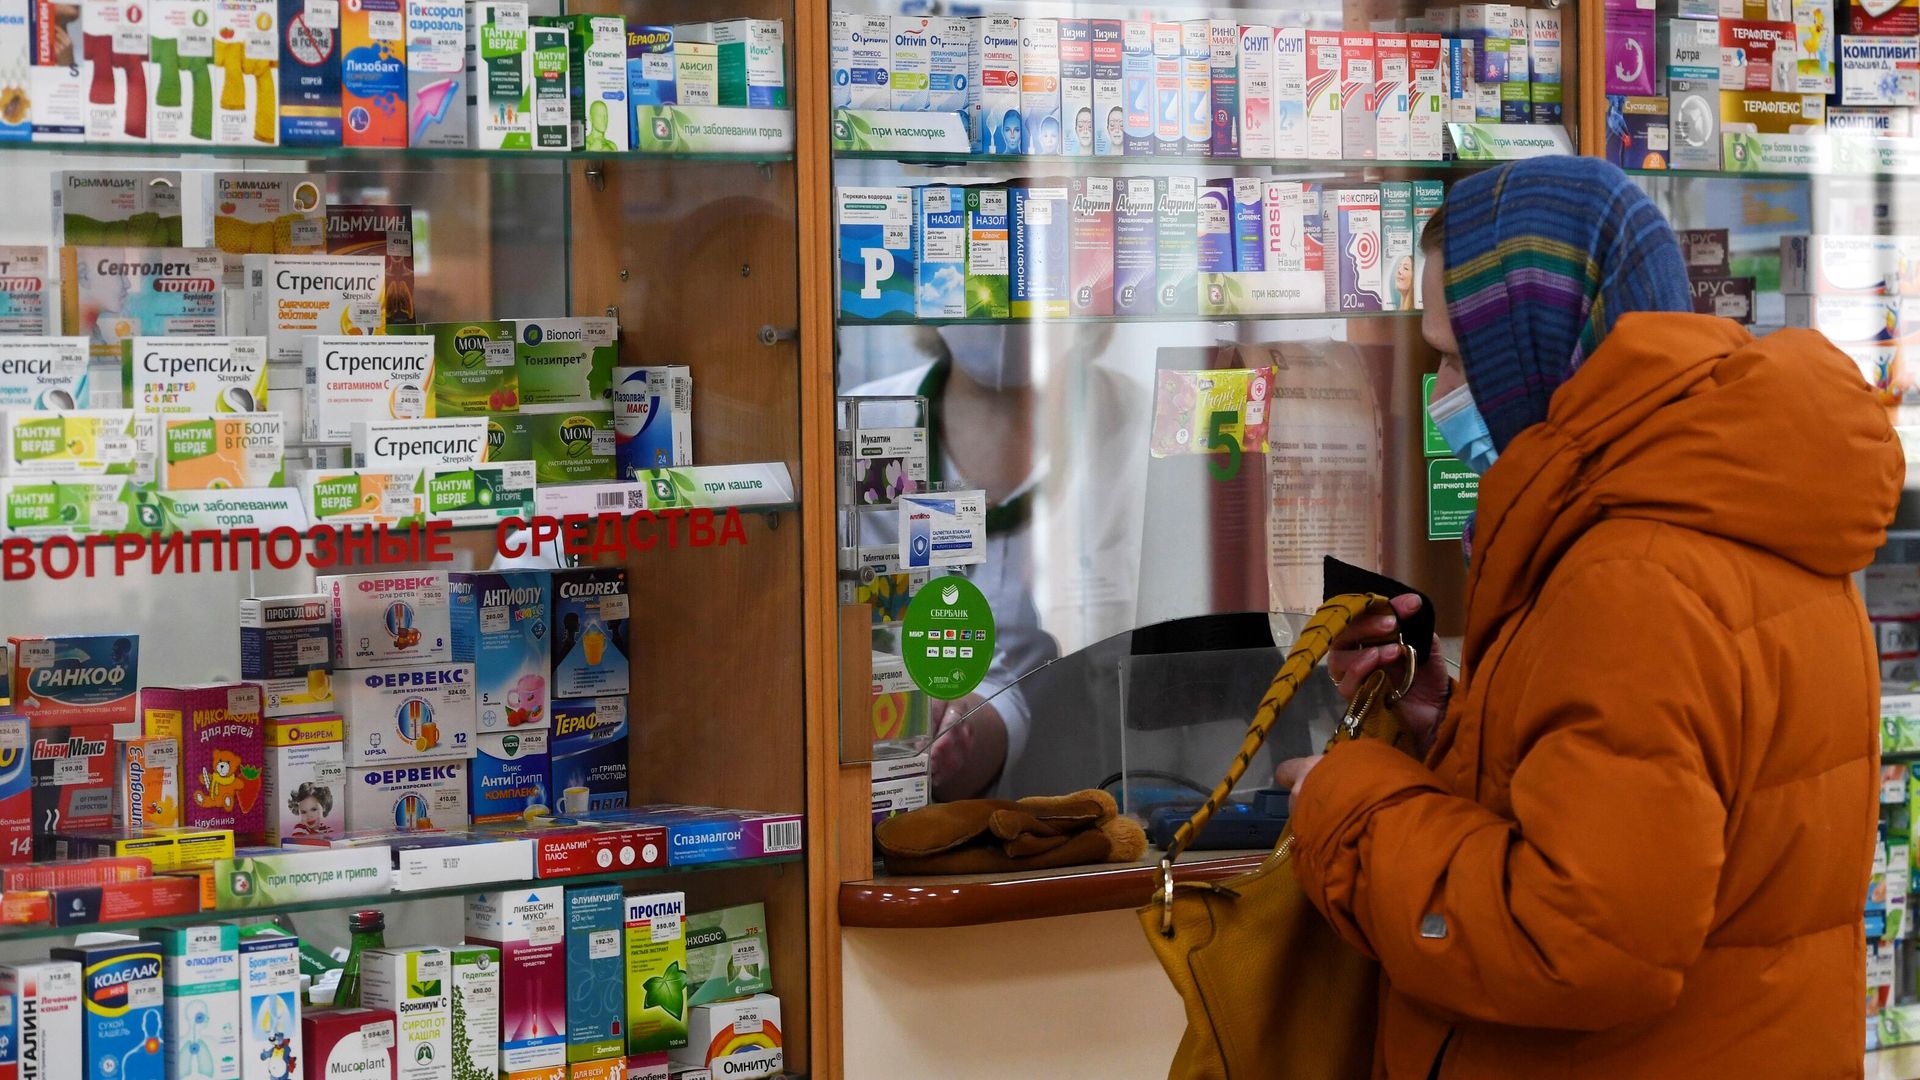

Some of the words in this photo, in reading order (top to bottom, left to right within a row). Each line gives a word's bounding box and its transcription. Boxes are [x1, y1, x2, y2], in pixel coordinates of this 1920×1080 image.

[409, 4, 464, 20] Гексорал
[410, 20, 464, 33] аэрозоль
[1535, 20, 1559, 30] АКВА
[484, 27, 523, 40] ТАНТУМ
[1062, 28, 1087, 41] Тизин
[1094, 29, 1119, 42] Тизин
[1212, 28, 1235, 37] РИНО
[1733, 28, 1782, 40] ТЕРАФЛЕКС
[627, 31, 671, 47] ТЕРАФЛЮ
[895, 35, 927, 47] Otrivin
[984, 36, 1018, 48] Отривин
[1244, 37, 1269, 52] СНУП
[489, 40, 519, 51] ВЕРДЕ
[1278, 38, 1303, 53] СНУП
[534, 52, 566, 61] ТАНТУМ
[1676, 48, 1699, 60] Артра
[1844, 45, 1917, 59] КОМПЛИВИТ
[347, 60, 400, 73] Лизобакт
[538, 62, 562, 71] ВЕРДЕ
[680, 62, 713, 72] АБИСИЛ
[1625, 101, 1657, 112] Сустагард
[1744, 101, 1800, 114] ТЕРАФЛЕКС
[684, 124, 700, 137] при
[702, 124, 755, 138] заболевании
[758, 126, 783, 138] горла
[872, 126, 891, 138] при
[893, 127, 946, 138] насморке
[1494, 137, 1510, 147] при
[1512, 138, 1554, 148] насморке
[68, 176, 136, 189] Граммидин
[219, 179, 280, 191] Граммидин
[842, 193, 867, 201] Перекись
[868, 193, 892, 201] водорода
[1383, 188, 1411, 198] Називин
[1415, 186, 1442, 196] Називин
[1073, 194, 1111, 213] Африн
[1158, 194, 1196, 213] Африн
[1340, 193, 1378, 203] НОКСПРЕЙ
[931, 214, 961, 224] НАЗОЛ
[976, 216, 1005, 225] НАЗОЛ
[1237, 213, 1261, 222] Синекс
[1269, 188, 1281, 252] nasic
[1018, 196, 1026, 297] РИНОФЛУИМУЦИЛ
[1277, 258, 1300, 267] Назик
[156, 278, 214, 292] тотал
[277, 271, 376, 294] Стрепсилс
[342, 292, 371, 301] Strepsils
[1252, 288, 1265, 299] при
[1266, 289, 1300, 298] насморке
[1343, 294, 1357, 308] 20
[458, 338, 486, 350] МОМ
[326, 351, 424, 375] Стрепсилс
[524, 355, 582, 368] Тонзипрет
[144, 383, 164, 393] ДЛЯ
[166, 382, 196, 392] ДЕТЕЙ
[333, 382, 382, 390] витамином
[384, 380, 389, 389] С
[614, 391, 646, 402] Лазолван
[626, 403, 648, 414] МАКС
[14, 425, 62, 439] ТАНТУМ
[168, 429, 212, 440] ТАНТУМ
[224, 424, 242, 435] ОТ
[245, 422, 280, 434] БОЛИ
[562, 428, 592, 440] МОМ
[225, 437, 231, 449] В
[235, 436, 274, 448] ГОРЛЕ
[860, 434, 891, 444] Мукалтин
[21, 439, 56, 452] ВЕРДЕ
[174, 441, 207, 453] ВЕРДЕ
[374, 437, 478, 460] Стрепсилс
[1207, 411, 1241, 481] 5
[442, 455, 473, 464] Strepsils
[316, 483, 357, 495] ТАНТУМ
[432, 480, 472, 491] ТАНТУМ
[704, 482, 725, 495] при
[728, 479, 762, 491] кашле
[1433, 482, 1464, 491] аптечного
[8, 493, 55, 505] ТАНТУМ
[321, 496, 352, 508] ВЕРДЕ
[437, 493, 467, 504] ВЕРДЕ
[14, 507, 49, 519] ВЕРДЕ
[174, 502, 200, 515] при
[204, 499, 288, 511] заболевании
[217, 515, 254, 527] горла
[2, 518, 454, 581] ВОГРИППОЗНЫЕ
[496, 506, 748, 562] СРЕДСТВА
[863, 554, 883, 562] Таблетки
[359, 577, 435, 592] ФЕРВЕКС
[560, 582, 620, 598] COLDREX
[483, 587, 542, 607] АНТИФЛУ
[931, 609, 968, 618] СБЕРБАНК
[332, 581, 344, 659] ФЕРВЕКС
[37, 665, 126, 688] РАНКОФ
[366, 670, 464, 688] ФЕРВЕКС
[193, 709, 260, 731] МАКСИКОЛД
[201, 730, 220, 742] для
[222, 724, 253, 737] детей
[288, 727, 334, 741] ОРВИРЕМ
[454, 733, 467, 744] 12
[33, 738, 108, 760] АнвиМакс
[502, 764, 522, 773] Викс
[599, 764, 627, 773] ГРИППА
[365, 765, 457, 785] ФЕРВЕКС
[481, 773, 543, 788] АнтиГрипп
[484, 787, 539, 800] КОМПЛЕКС
[195, 817, 235, 828] Клубника
[673, 831, 741, 847] Спазмалгон
[10, 837, 31, 856] 14
[545, 841, 588, 853] СЕДАЛЬГИН
[545, 852, 569, 862] ПЛЮС
[268, 875, 287, 888] при
[289, 871, 333, 887] простуде
[345, 867, 378, 881] гриппе
[572, 893, 618, 905] ФЛУИМУЦИЛ
[513, 903, 554, 914] ЛИБЕКСИН
[630, 902, 681, 920] ПРОСПАН
[522, 912, 544, 922] МУКО
[186, 955, 233, 967] ФЛЮДИТЕК
[94, 962, 160, 988] КОДЕЛАК
[110, 987, 125, 996] НЕО
[41, 995, 77, 1004] Лечение
[400, 999, 438, 1015] Бронхикум
[441, 996, 447, 1007] С
[41, 1004, 69, 1013] кашля
[402, 1019, 433, 1032] СИРОП
[435, 1017, 446, 1028] ОТ
[408, 1030, 441, 1042] КАШЛЯ
[596, 1045, 621, 1054] Zambon
[331, 1058, 385, 1074] Mucoplant
[724, 1058, 776, 1075] Омнитус
